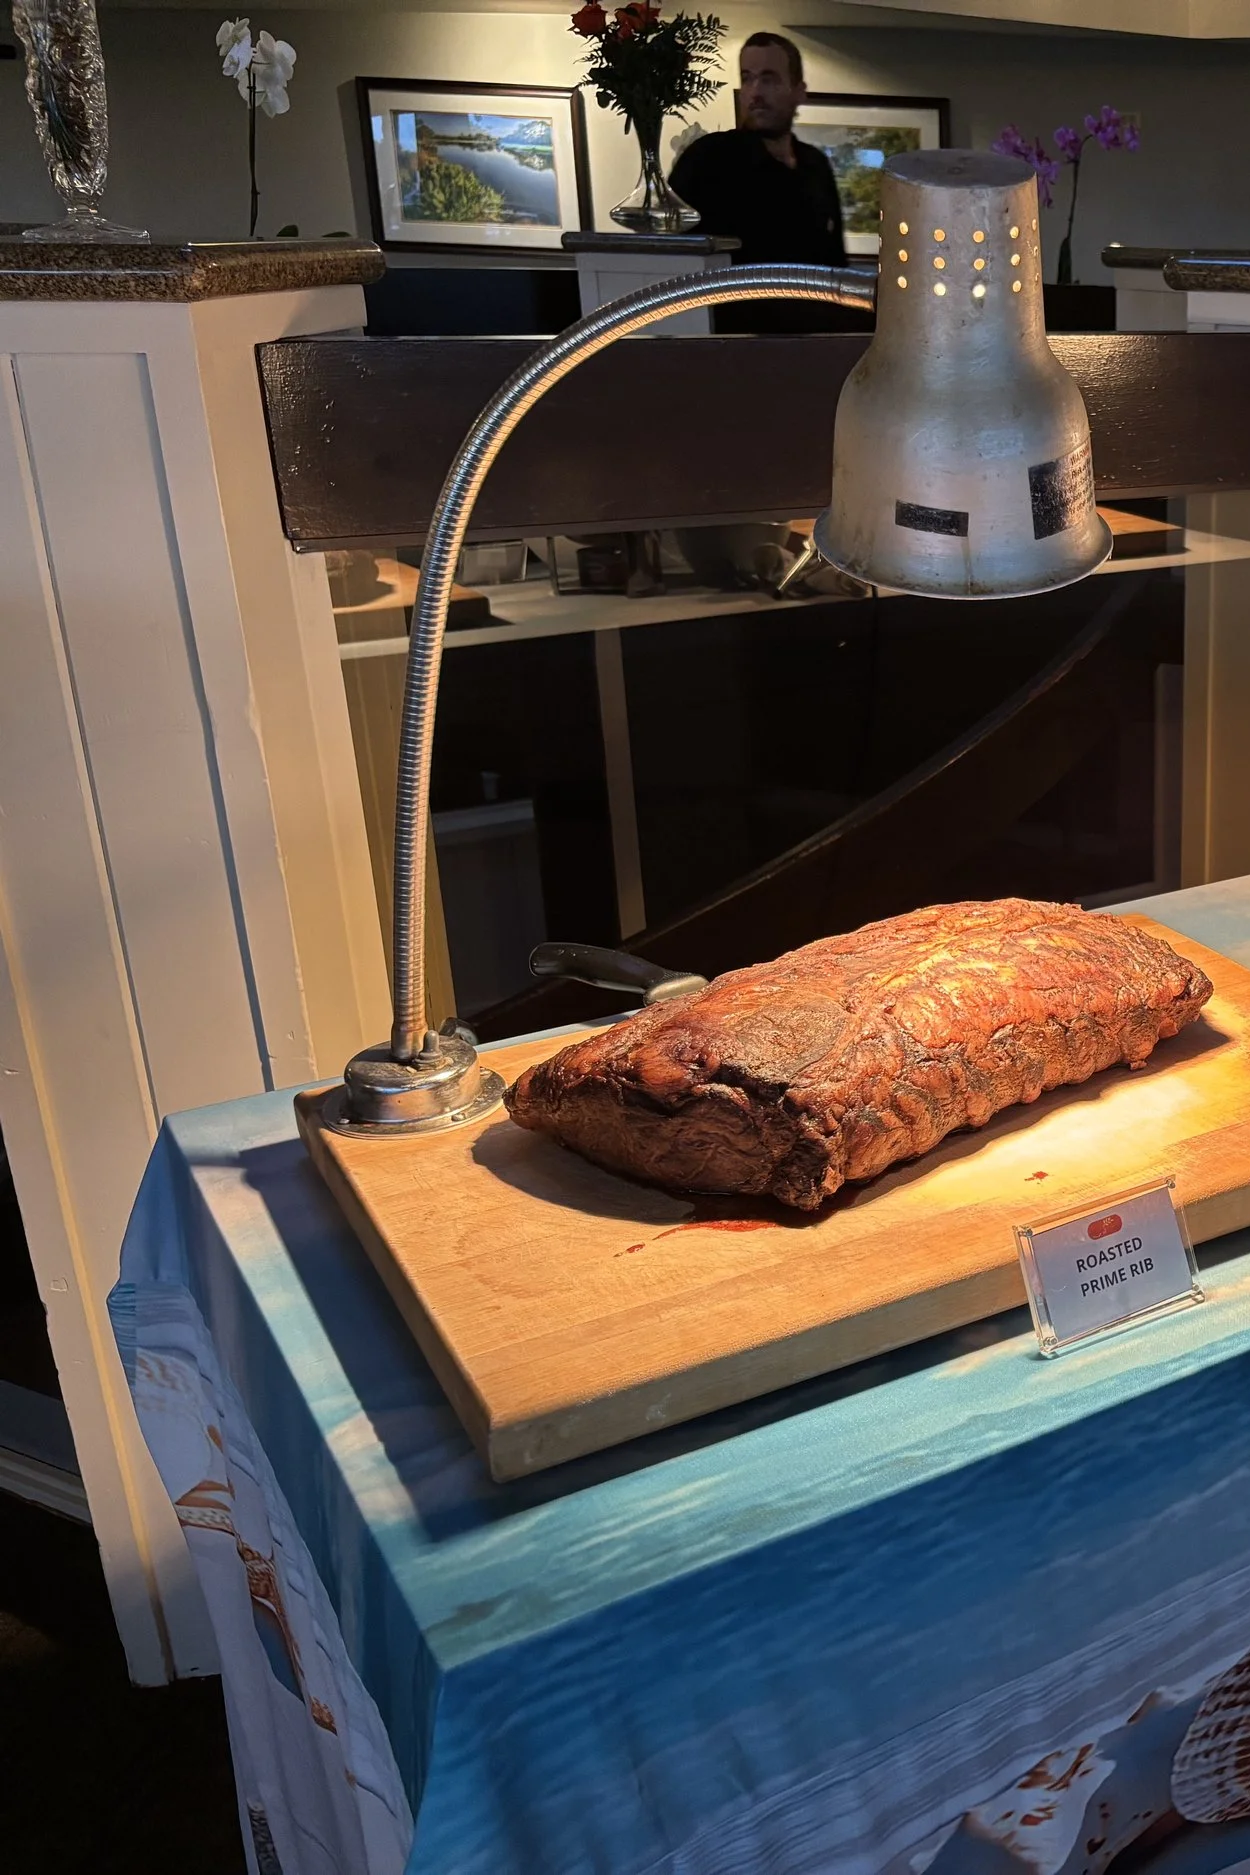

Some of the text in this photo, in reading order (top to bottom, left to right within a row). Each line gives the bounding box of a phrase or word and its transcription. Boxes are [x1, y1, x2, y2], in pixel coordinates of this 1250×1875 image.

[1076, 1237, 1142, 1273] ROASTED
[1080, 1257, 1154, 1297] PRIME RIB
